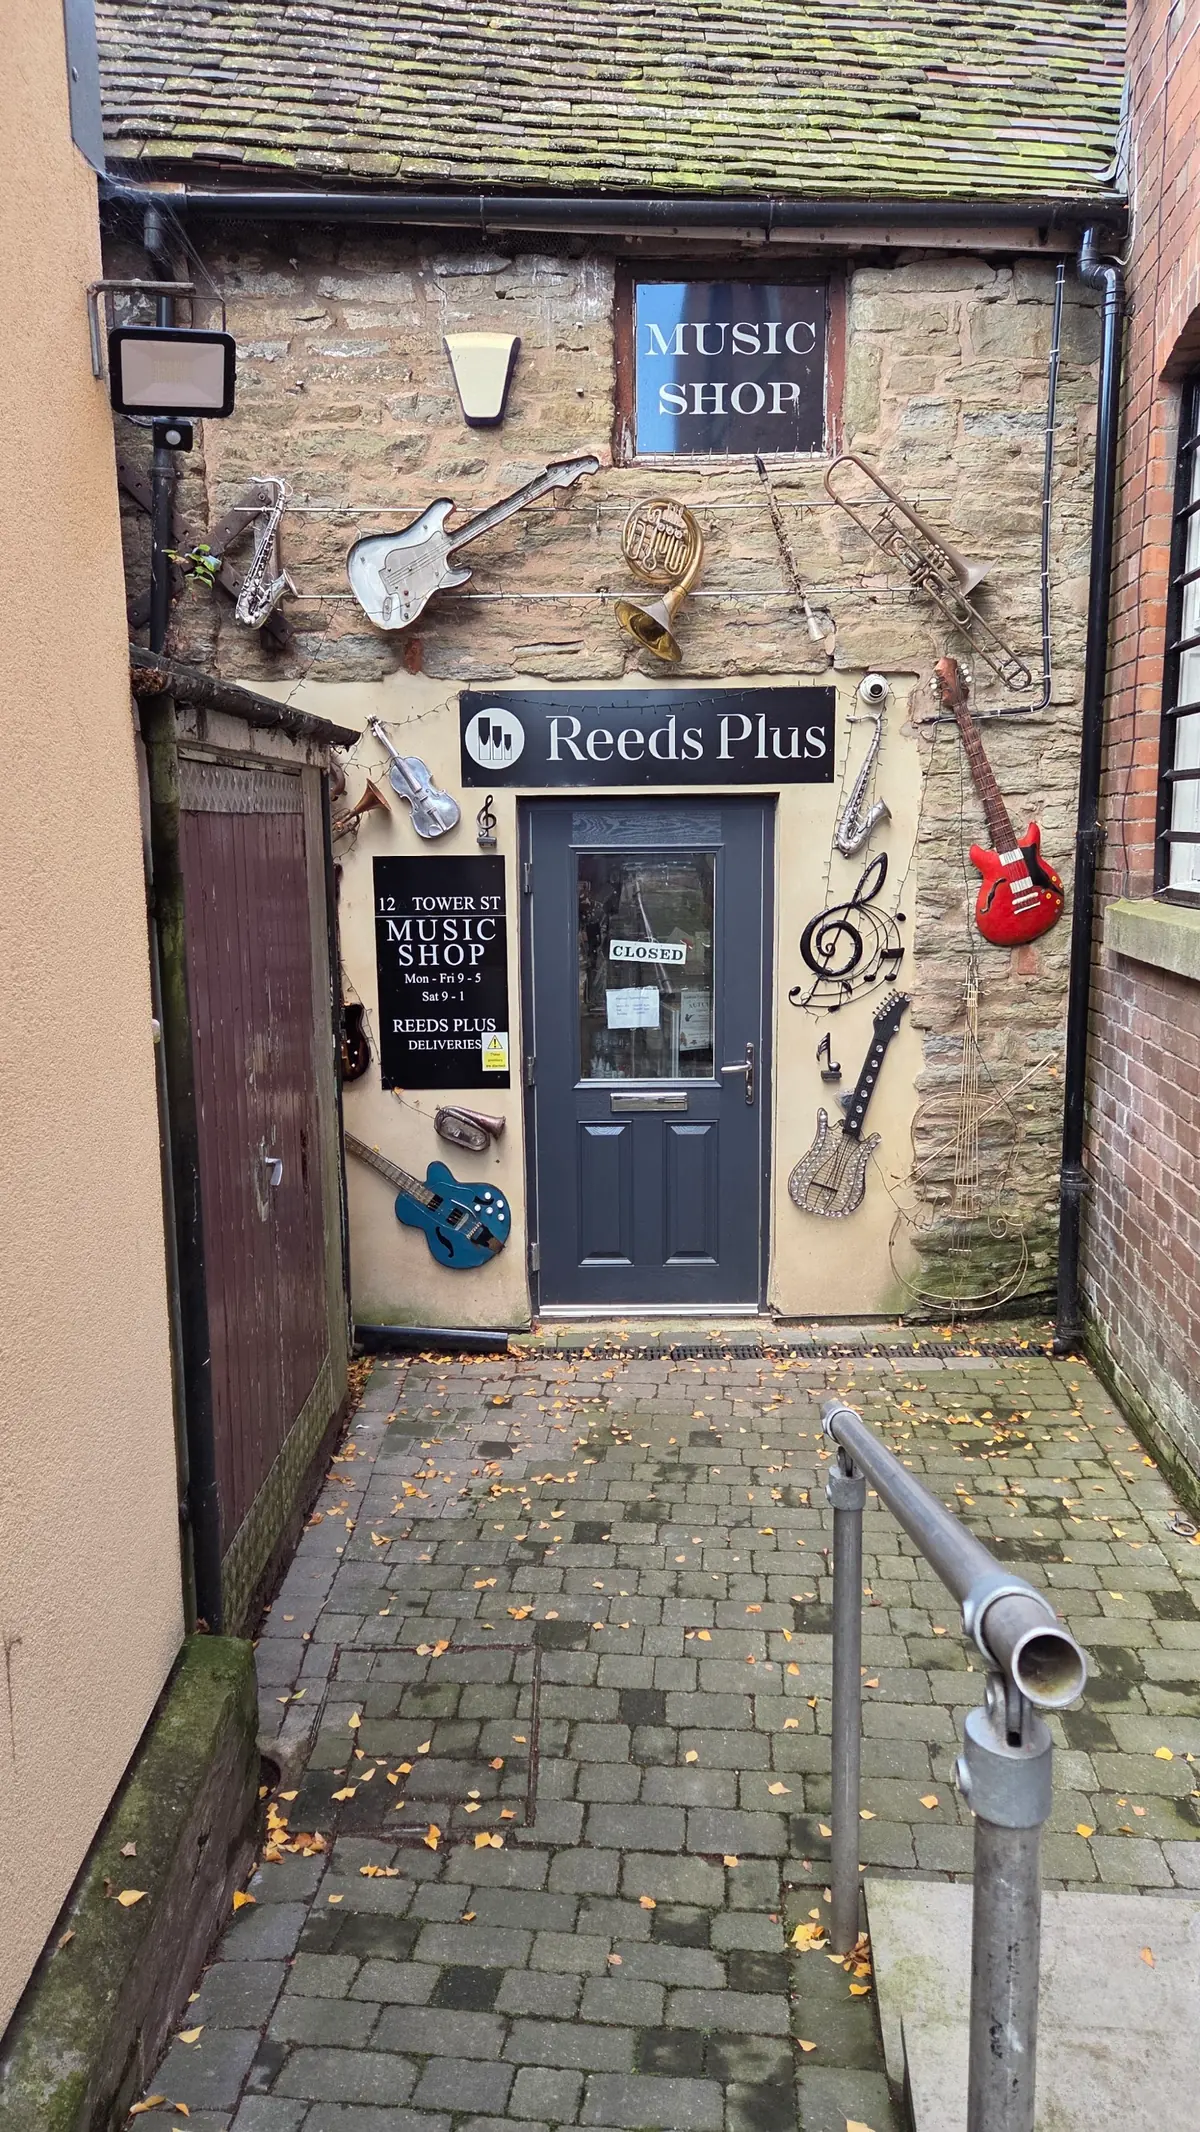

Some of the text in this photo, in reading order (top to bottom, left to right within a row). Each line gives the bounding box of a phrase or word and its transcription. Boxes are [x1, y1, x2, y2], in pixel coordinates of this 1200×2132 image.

[645, 321, 816, 356] MUSIC
[658, 381, 801, 416] SHOP
[545, 713, 826, 762] Reeds Plus
[379, 895, 501, 911] 12 TOWER ST
[386, 918, 497, 942] MUSIC
[398, 943, 485, 967] SHOP
[612, 945, 684, 961] CLOSED
[404, 973, 429, 984] Mon
[439, 972, 455, 984] Fri
[457, 972, 465, 984] 9
[474, 972, 482, 983] 5
[422, 991, 440, 1002] Sat
[441, 990, 449, 1002] 9
[459, 991, 464, 1001] 1
[392, 1018, 496, 1032] REEDS PLUS
[408, 1039, 482, 1050] DELIVERIES
